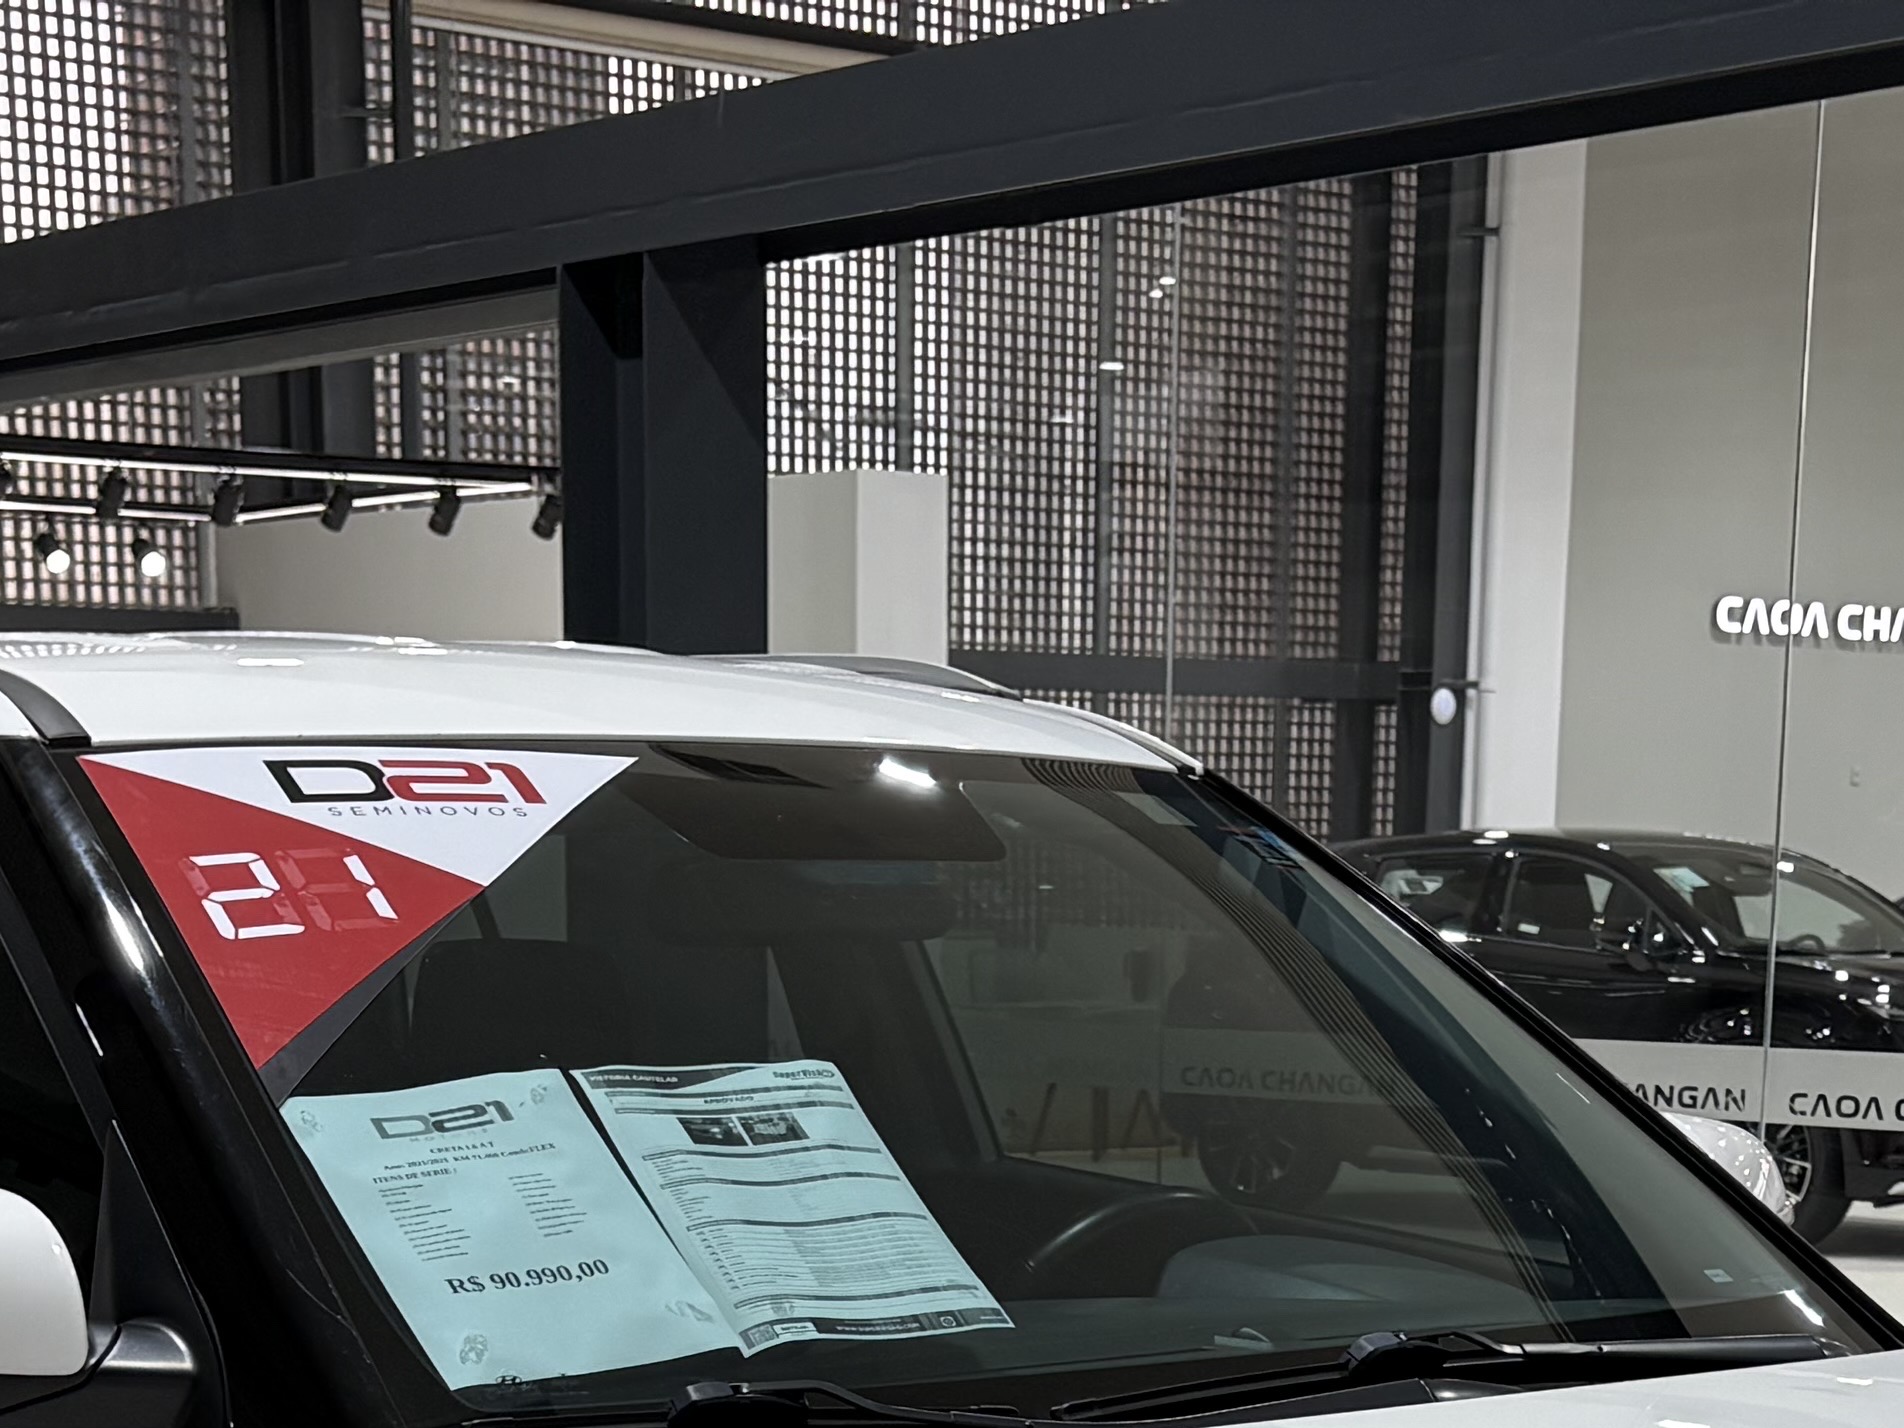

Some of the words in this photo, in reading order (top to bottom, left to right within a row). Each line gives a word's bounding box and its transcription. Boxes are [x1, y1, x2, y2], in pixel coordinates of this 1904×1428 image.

[1715, 594, 1830, 640] CAOA
[263, 759, 548, 804] D21
[326, 805, 529, 818] SEMINOVOS
[189, 850, 399, 941] 21
[369, 1099, 515, 1140] D21
[1788, 1092, 1884, 1122] CAOA
[444, 1274, 485, 1295] R$
[488, 1257, 611, 1291] 90.990,00
